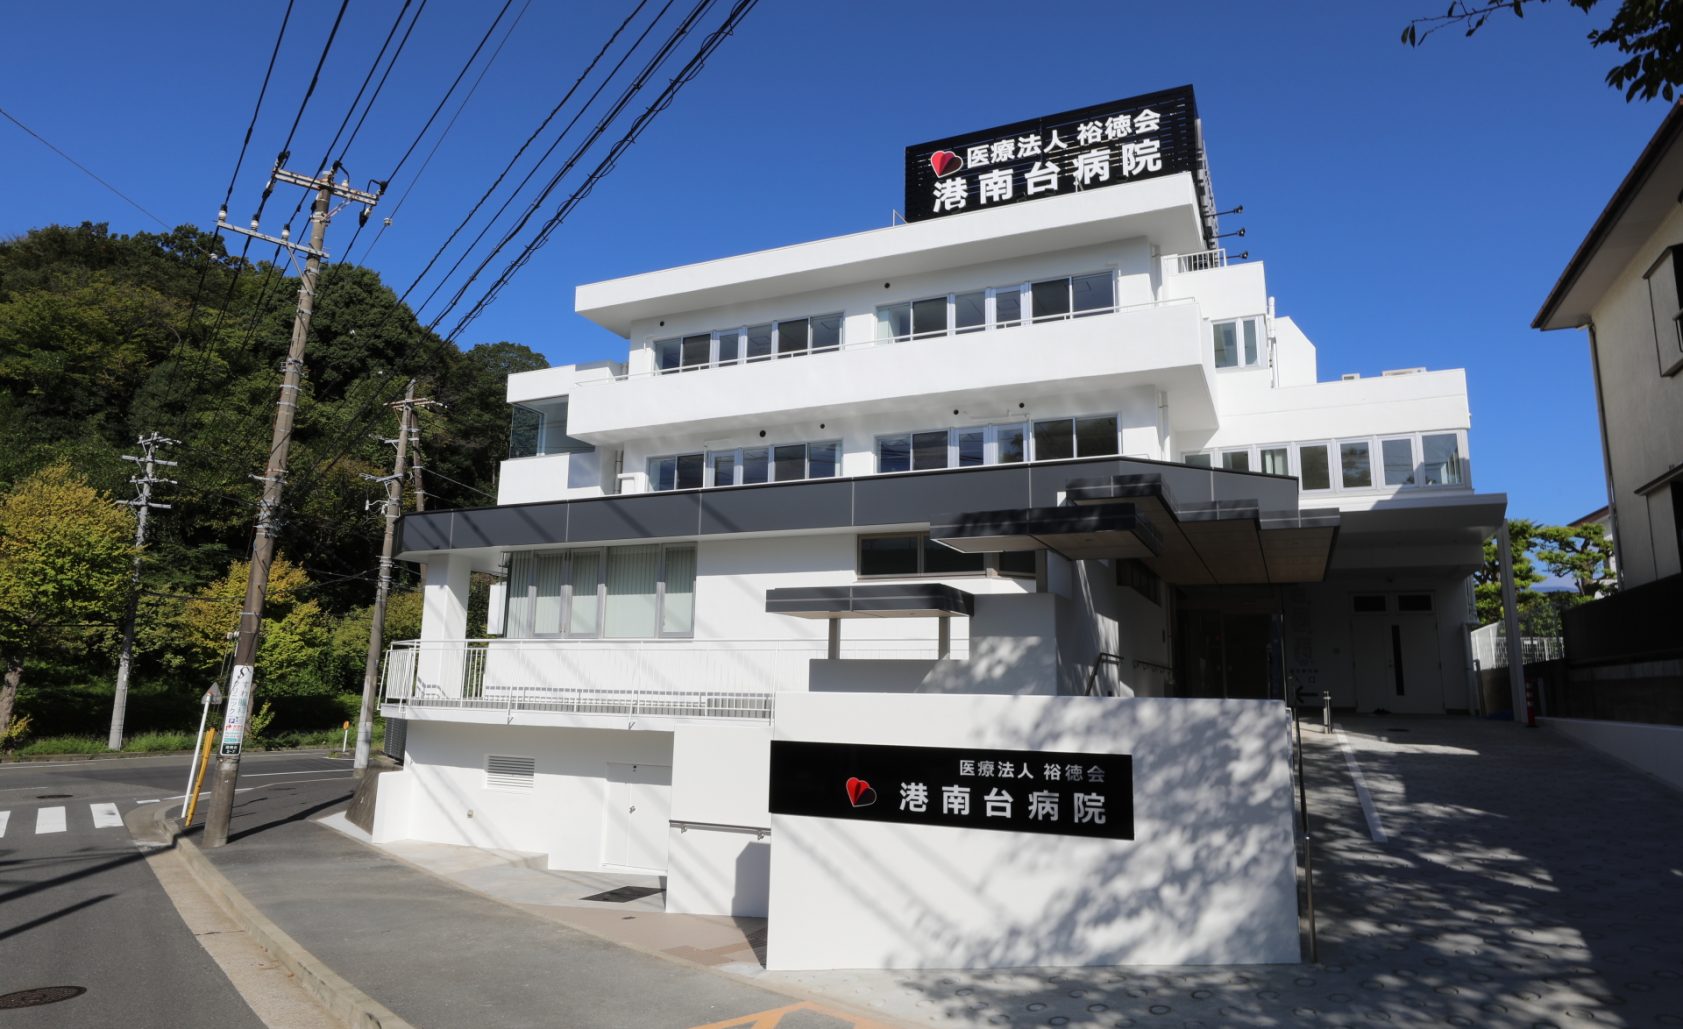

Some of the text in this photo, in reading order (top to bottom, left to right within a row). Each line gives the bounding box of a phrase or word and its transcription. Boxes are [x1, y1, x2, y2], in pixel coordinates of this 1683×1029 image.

[967, 109, 1161, 169] 医療法人 裕徳会
[932, 139, 1162, 213] 港南台病院
[959, 759, 1105, 783] 医療法人 裕徳会
[899, 782, 1107, 824] 港南台病院
